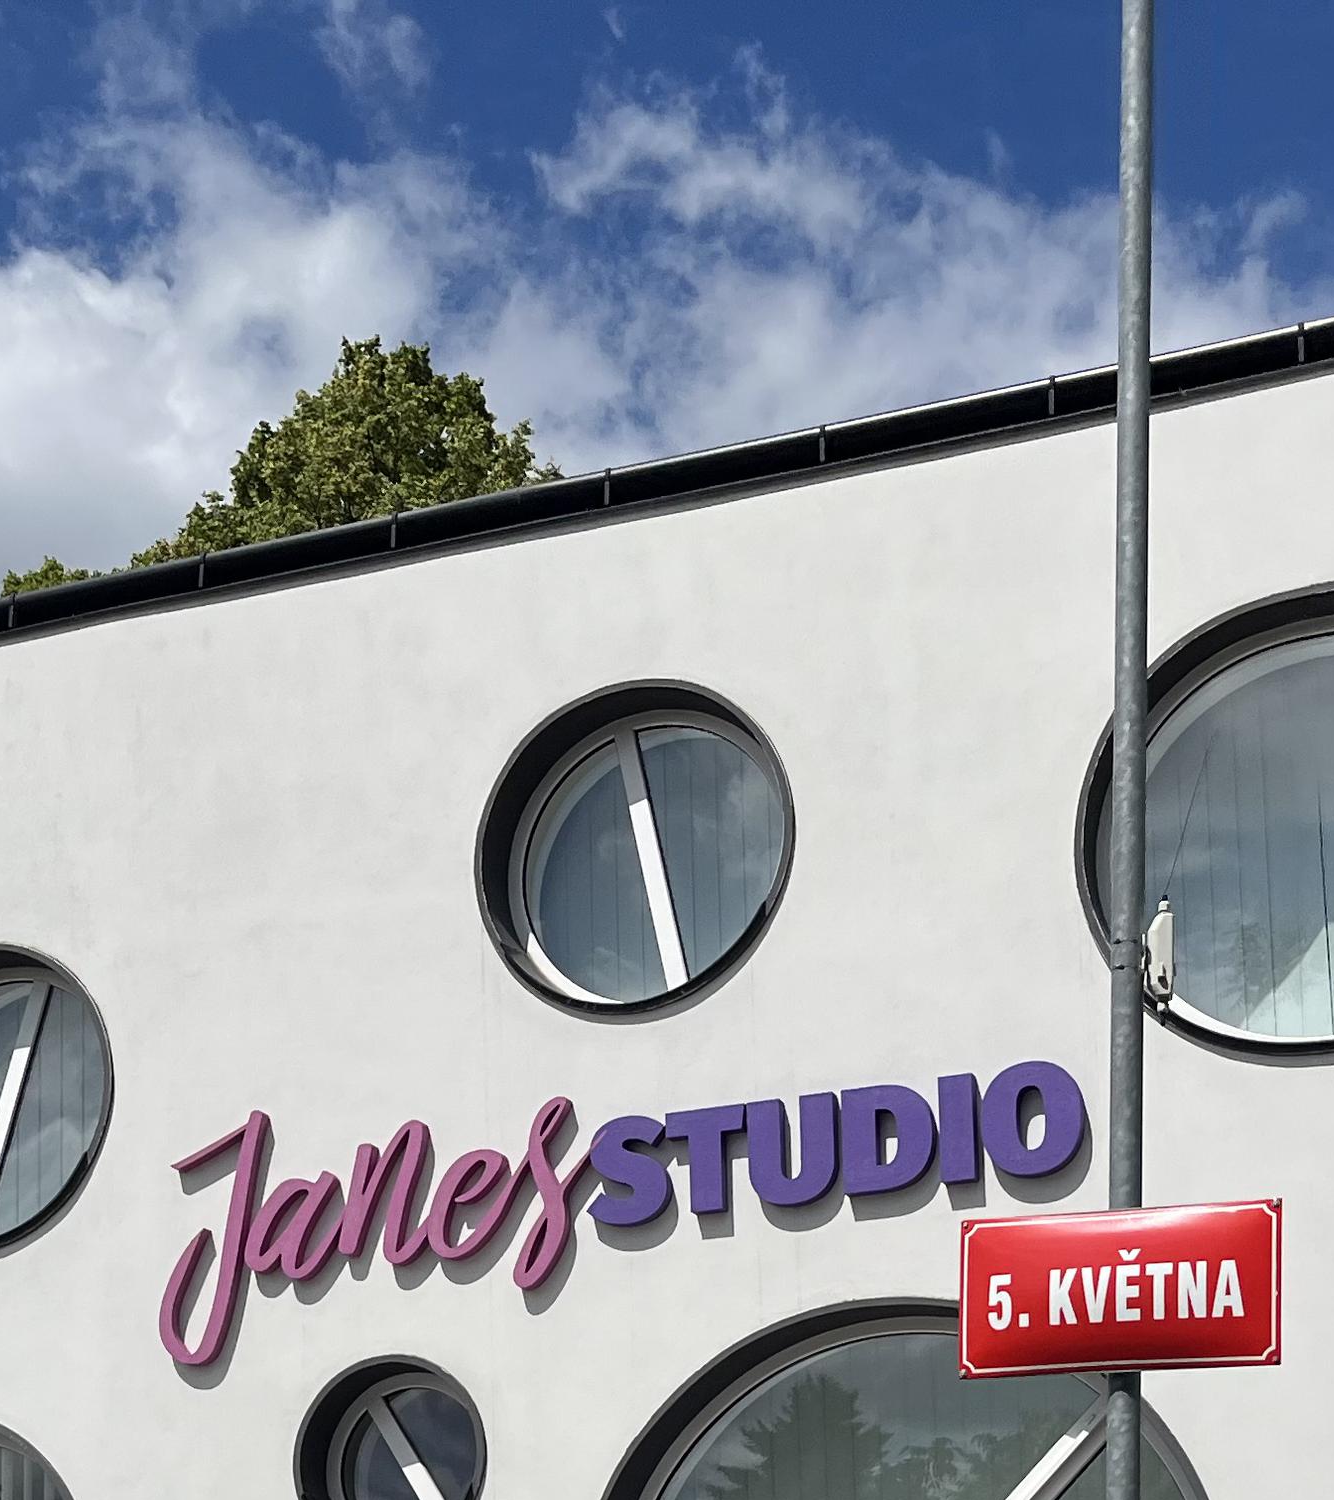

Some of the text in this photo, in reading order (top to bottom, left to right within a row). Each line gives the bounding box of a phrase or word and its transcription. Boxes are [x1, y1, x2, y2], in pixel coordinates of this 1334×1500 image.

[587, 1060, 1085, 1227] STUDIO
[987, 1247, 1245, 1331] 5. KVĚTNA
